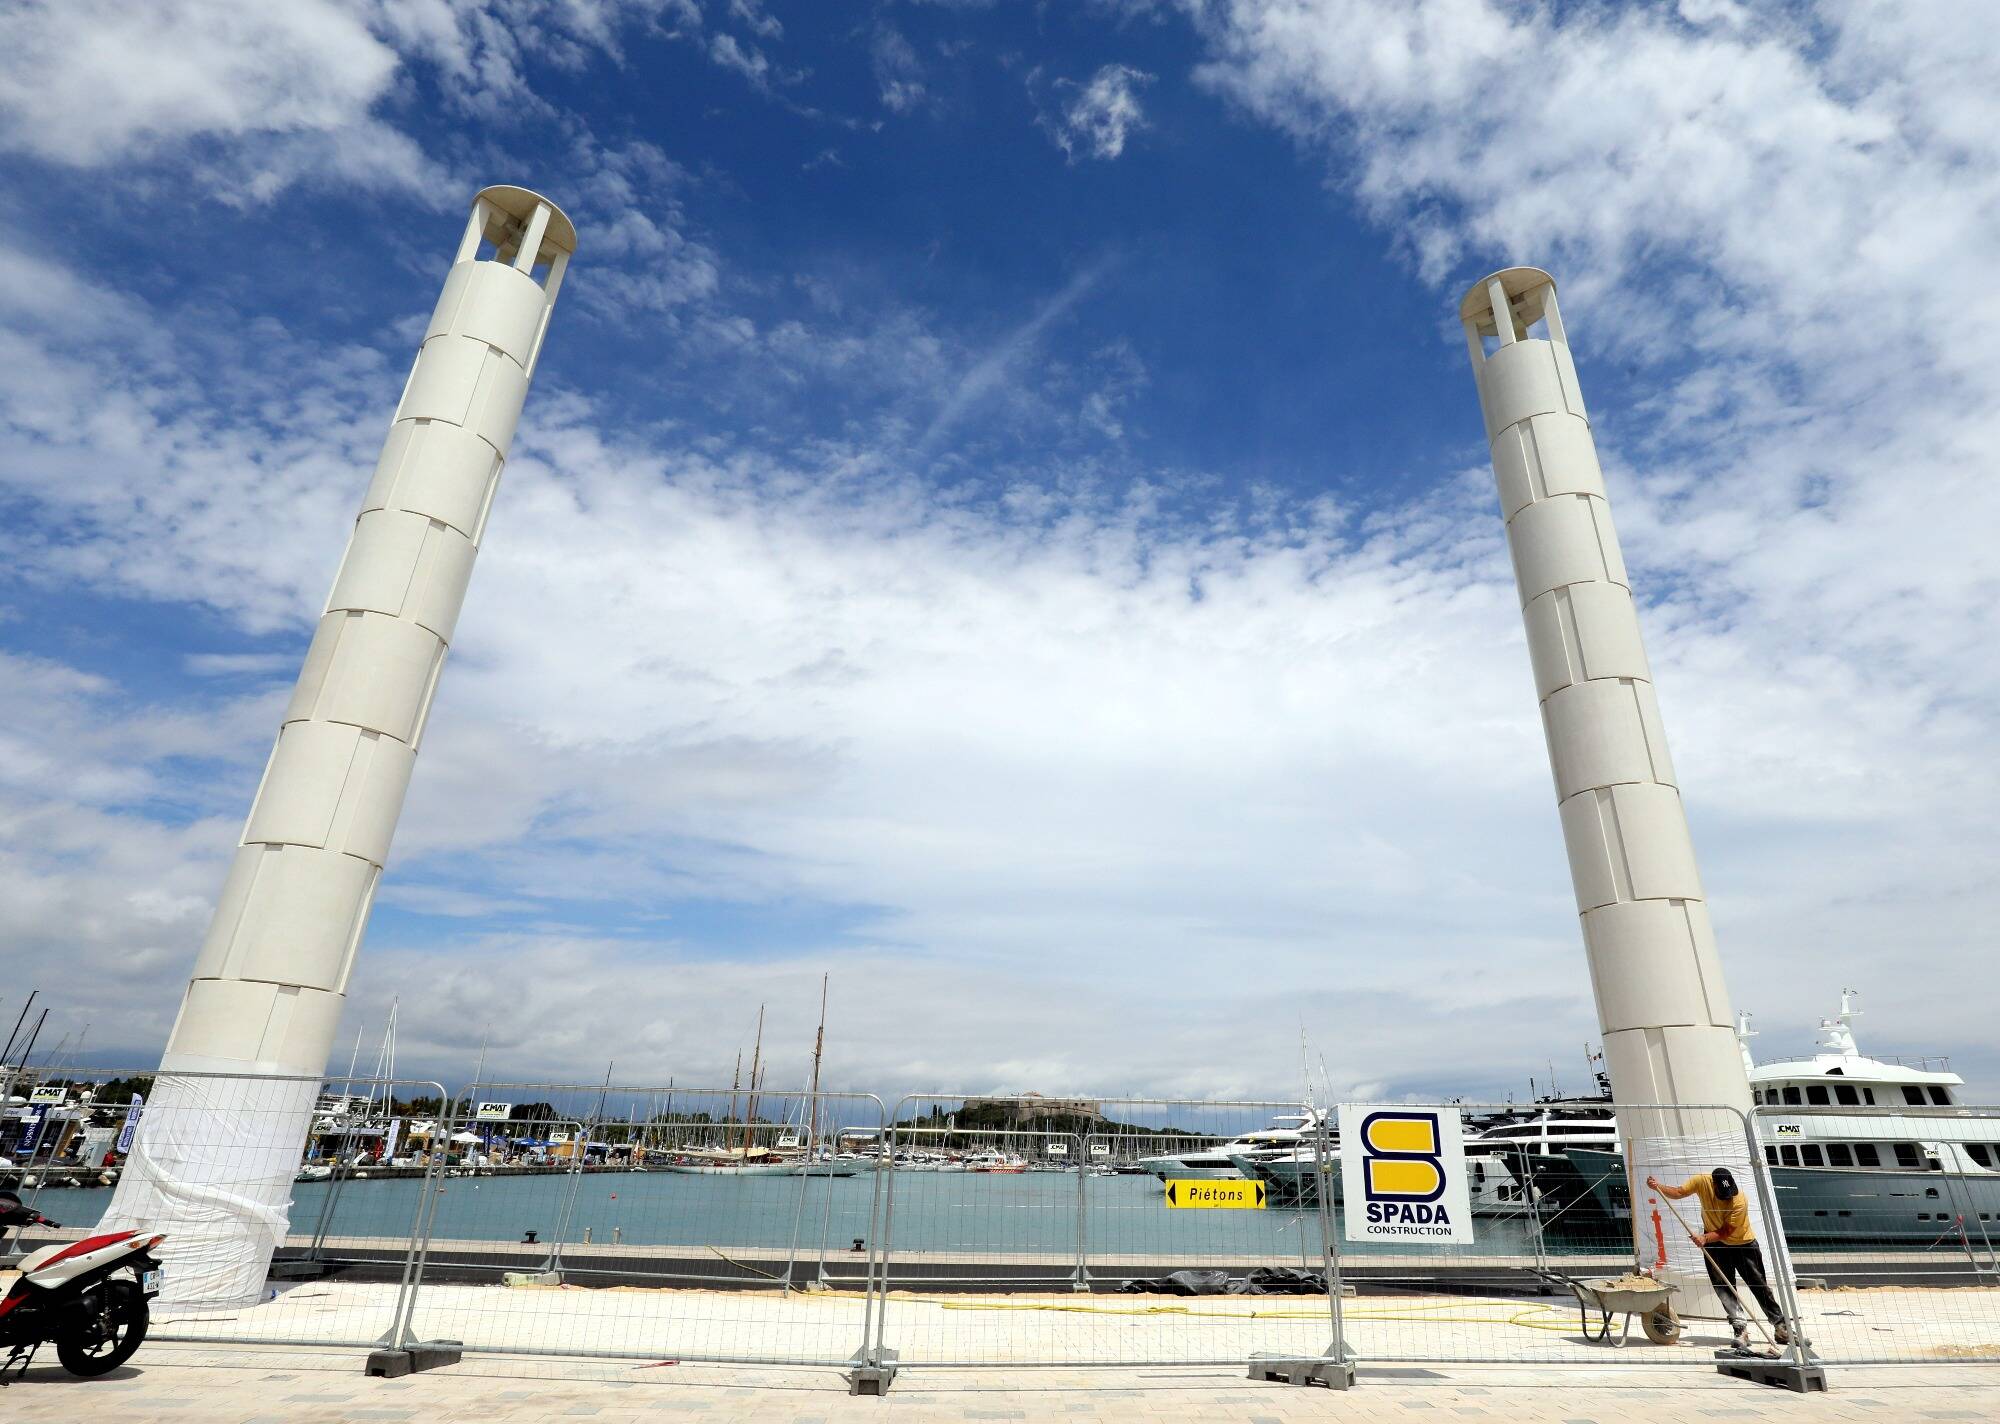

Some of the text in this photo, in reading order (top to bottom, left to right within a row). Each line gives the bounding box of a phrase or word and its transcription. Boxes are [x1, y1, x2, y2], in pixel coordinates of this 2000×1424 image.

[1189, 1187, 1244, 1201] Piétons
[1366, 1203, 1450, 1225] SPADA
[1367, 1225, 1452, 1236] CONSTRUCTION
